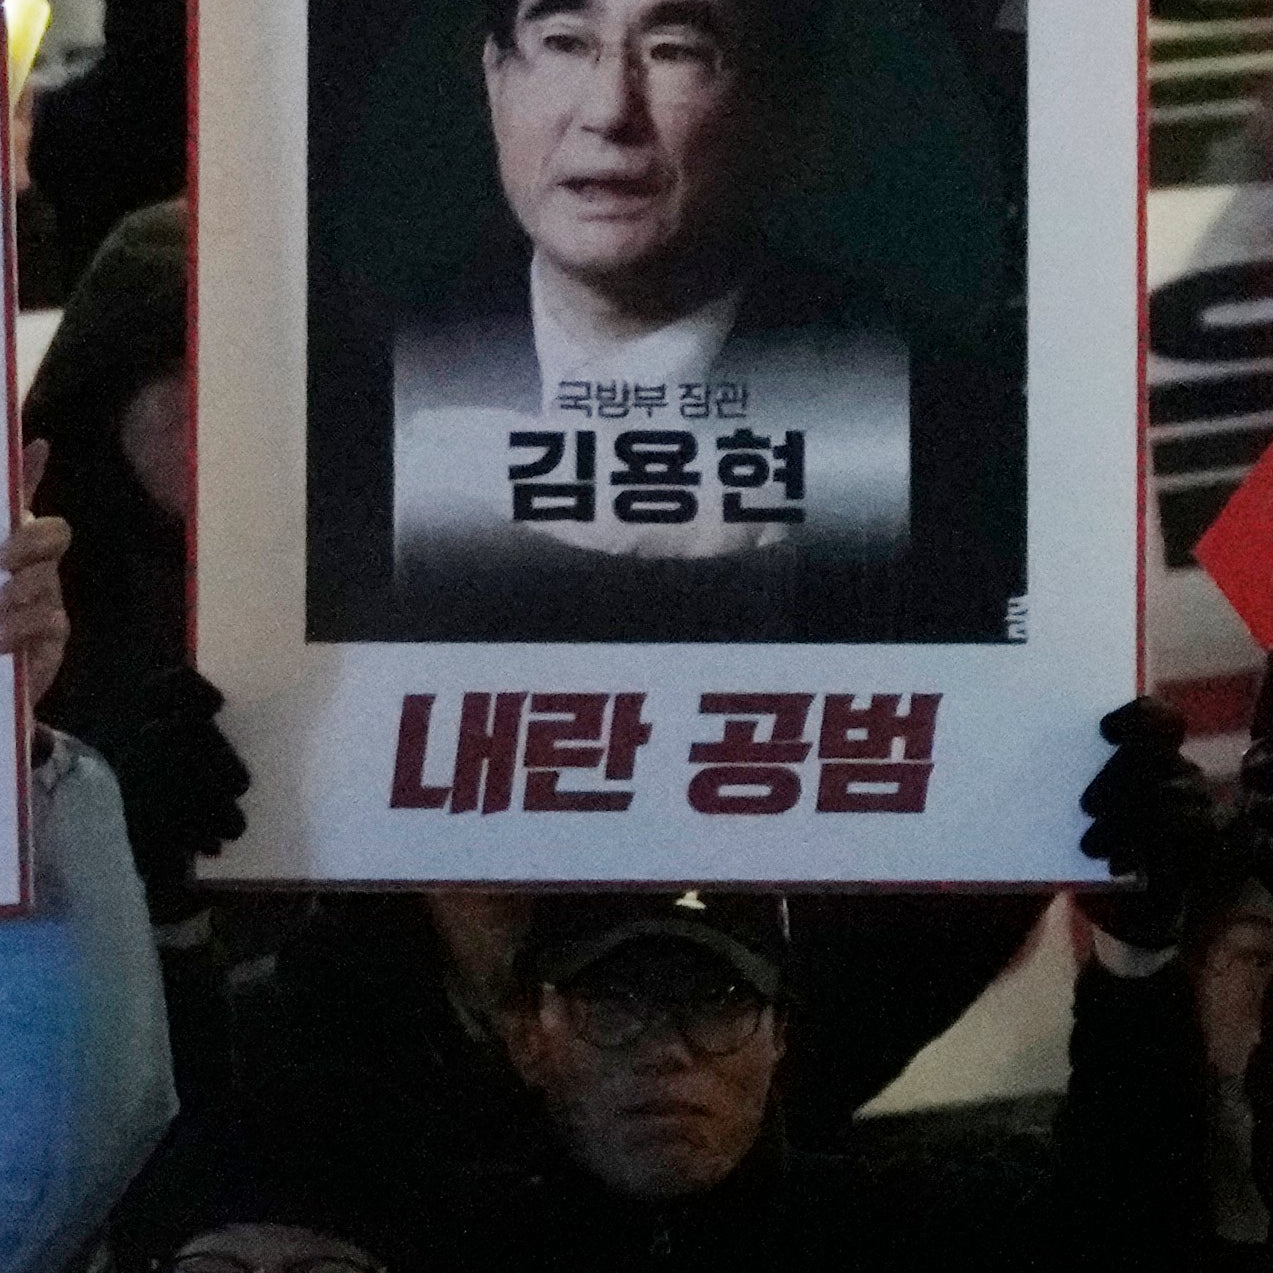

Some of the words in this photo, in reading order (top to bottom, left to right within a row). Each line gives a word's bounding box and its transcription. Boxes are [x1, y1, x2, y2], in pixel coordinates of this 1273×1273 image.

[557, 380, 669, 419] 국방부
[679, 382, 749, 420] 장관
[506, 428, 807, 525] 김용현
[389, 690, 653, 815] 내란
[686, 691, 944, 815] 공범
